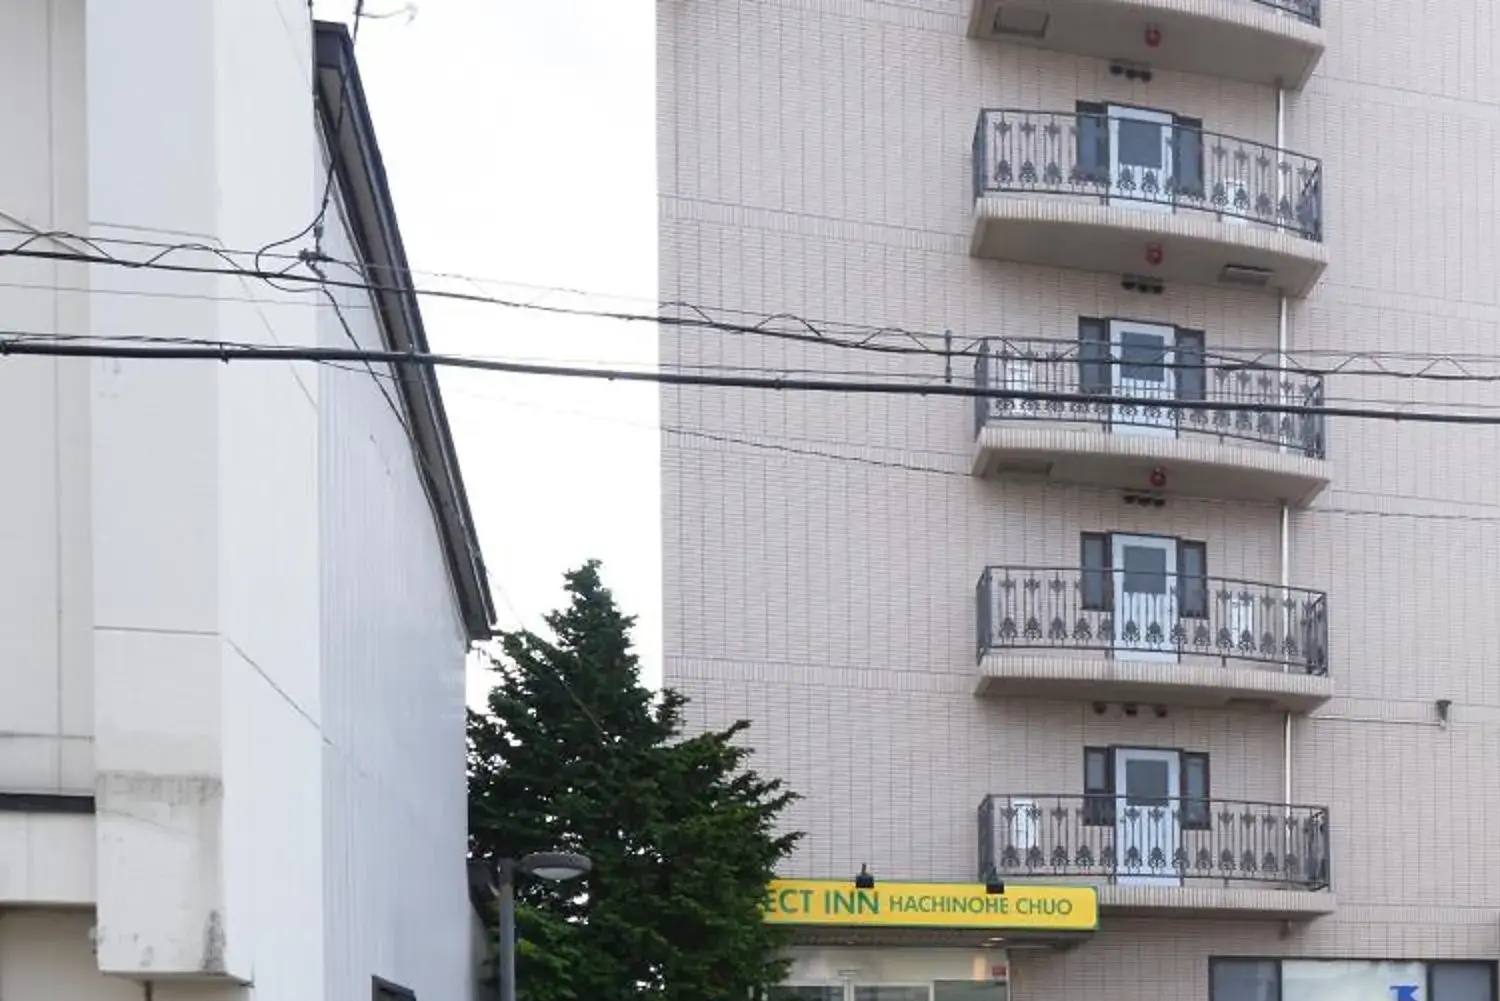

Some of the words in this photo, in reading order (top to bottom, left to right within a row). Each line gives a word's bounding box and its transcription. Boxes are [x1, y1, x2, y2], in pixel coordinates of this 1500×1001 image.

[824, 890, 879, 915] INN
[889, 894, 1009, 914] HACHINOHE
[1016, 898, 1072, 916] CHUO
